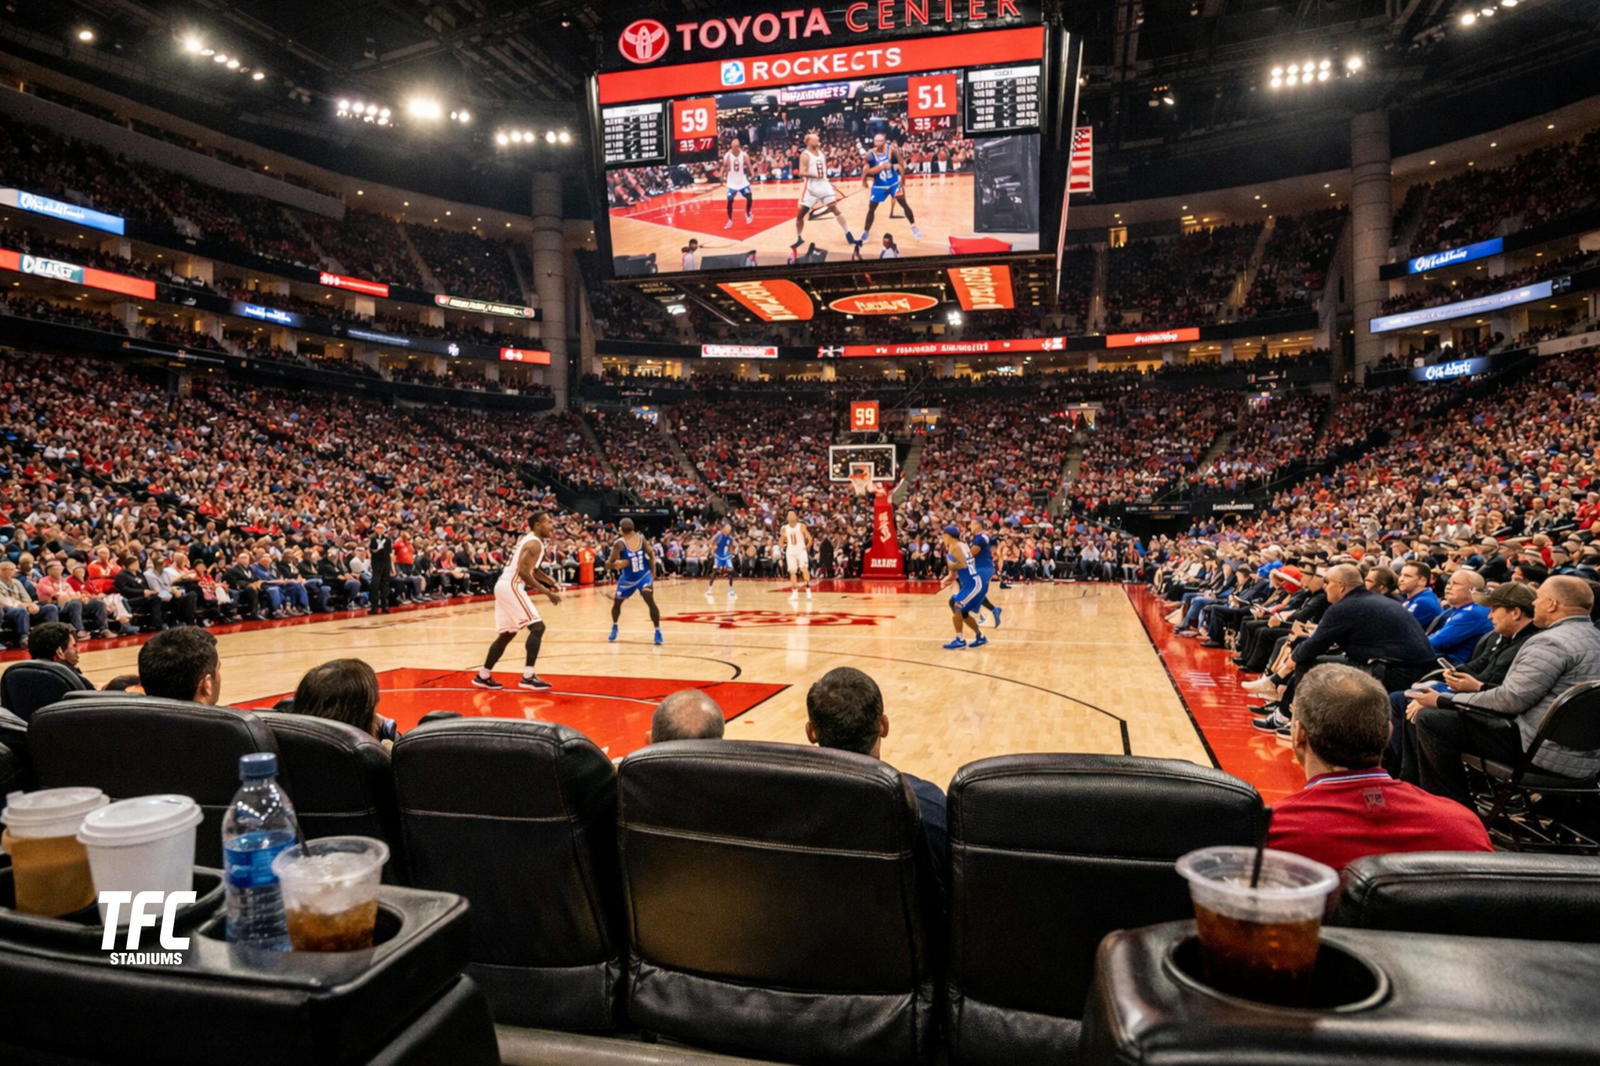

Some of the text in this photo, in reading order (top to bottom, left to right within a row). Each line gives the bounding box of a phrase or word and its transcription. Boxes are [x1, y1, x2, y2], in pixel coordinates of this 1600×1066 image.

[676, 0, 1021, 51] TOYOTA CENTER
[917, 84, 947, 109] 51
[681, 108, 708, 133] 59
